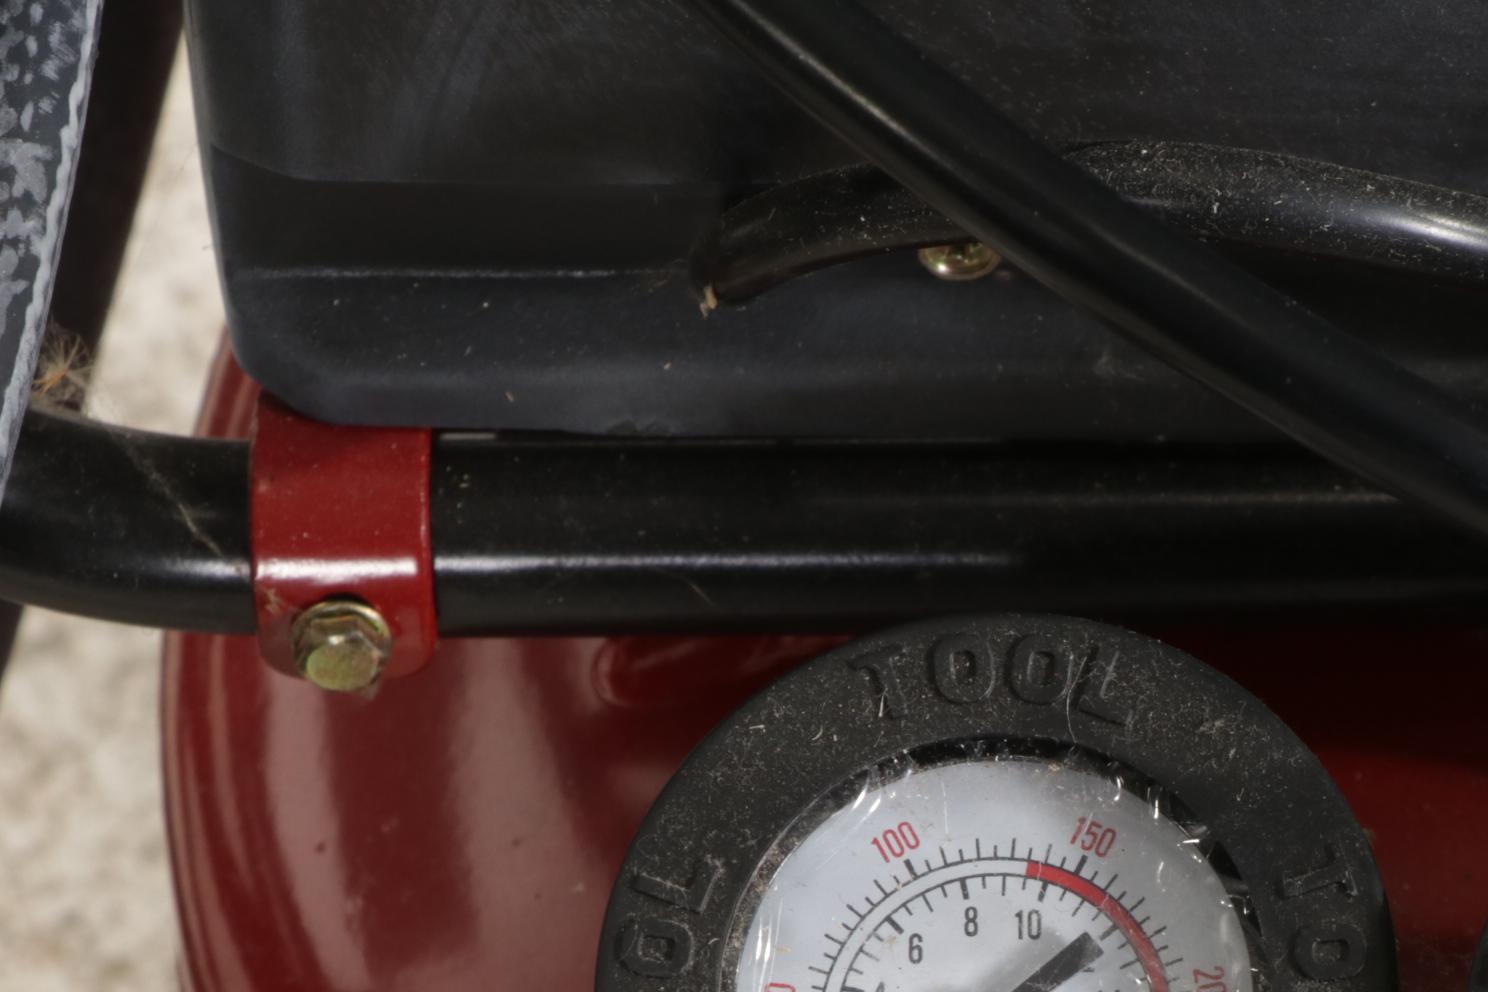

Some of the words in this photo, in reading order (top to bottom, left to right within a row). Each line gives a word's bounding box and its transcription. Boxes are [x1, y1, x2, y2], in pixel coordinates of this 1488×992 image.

[846, 632, 1134, 724] TOOL
[871, 821, 920, 863] 100
[1070, 816, 1117, 858] 150
[964, 907, 979, 937] 8
[1015, 910, 1042, 941] 10
[909, 933, 923, 964] 6
